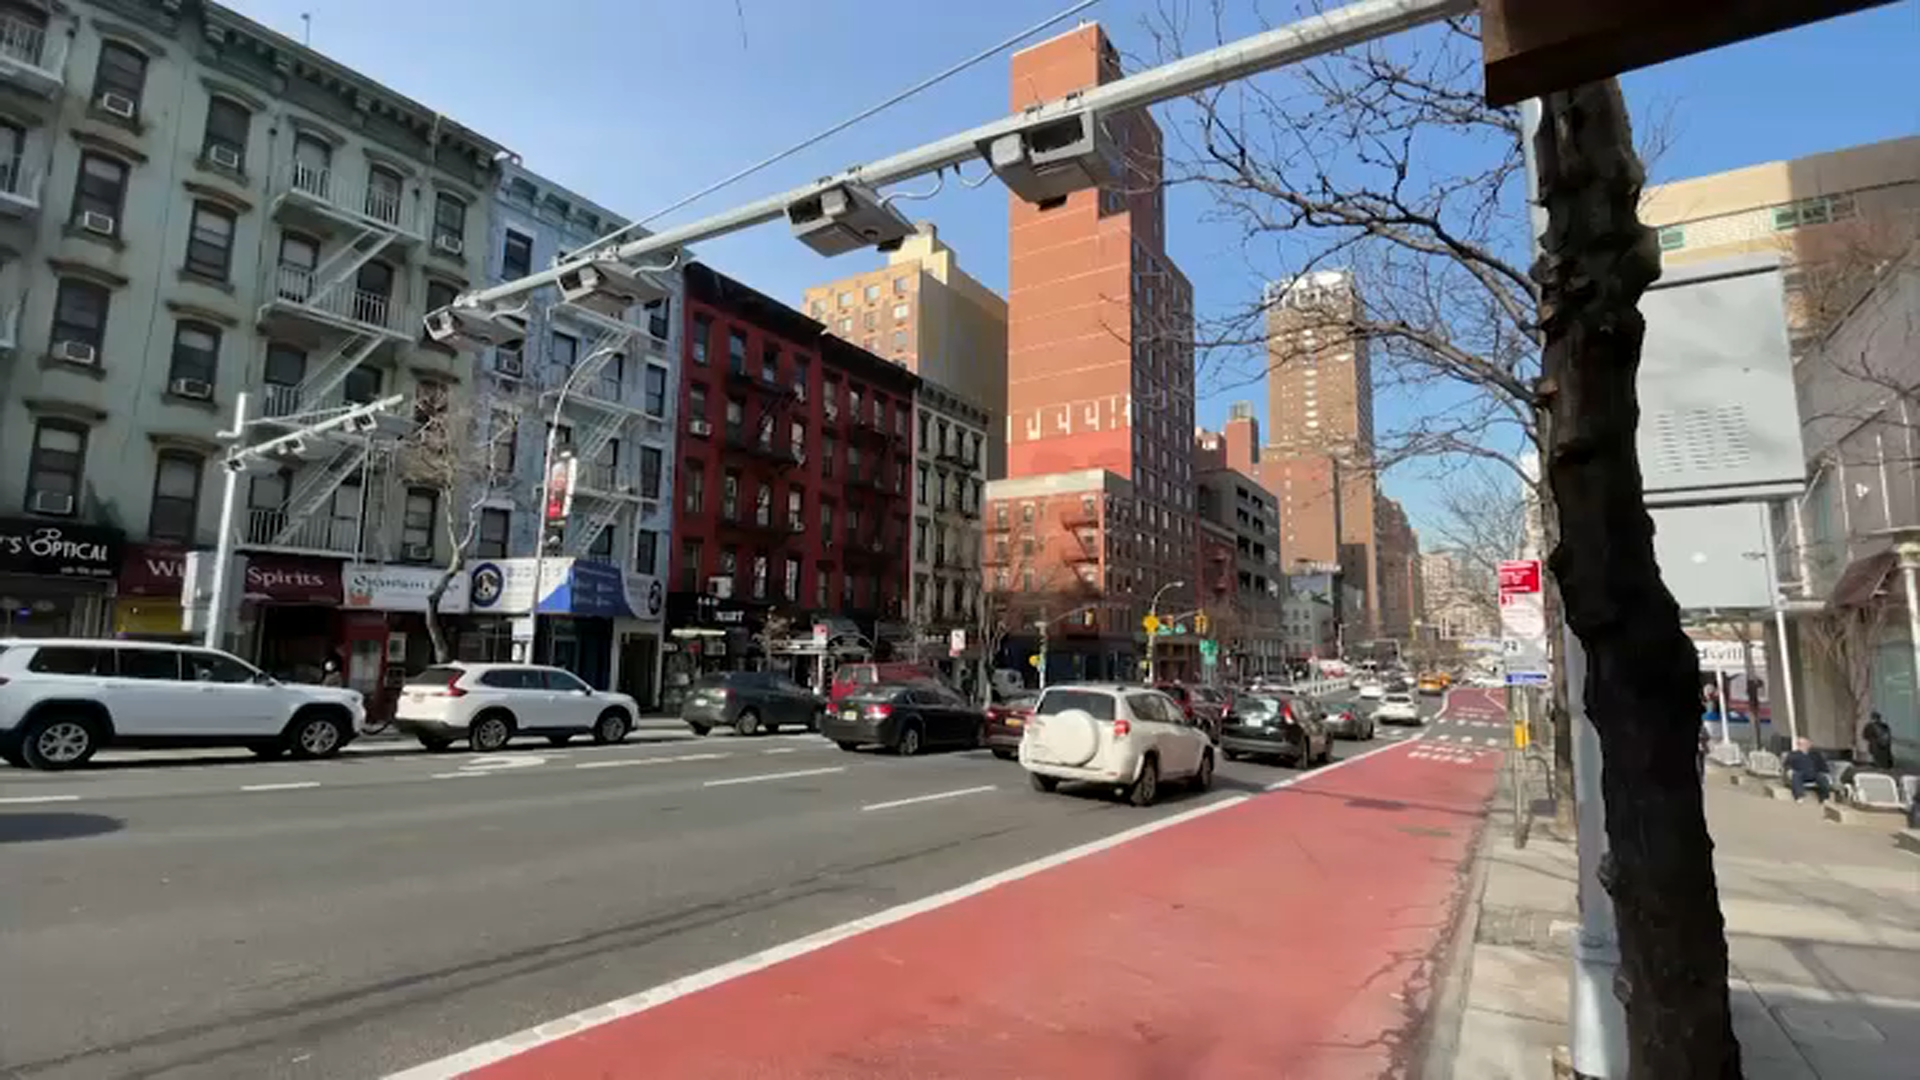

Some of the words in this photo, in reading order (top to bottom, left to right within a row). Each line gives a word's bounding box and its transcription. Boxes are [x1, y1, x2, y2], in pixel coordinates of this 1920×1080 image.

[28, 537, 108, 562] OPTICAL
[145, 558, 184, 578] Wi
[247, 566, 324, 587] Spirits
[1697, 646, 1744, 660] dwill
